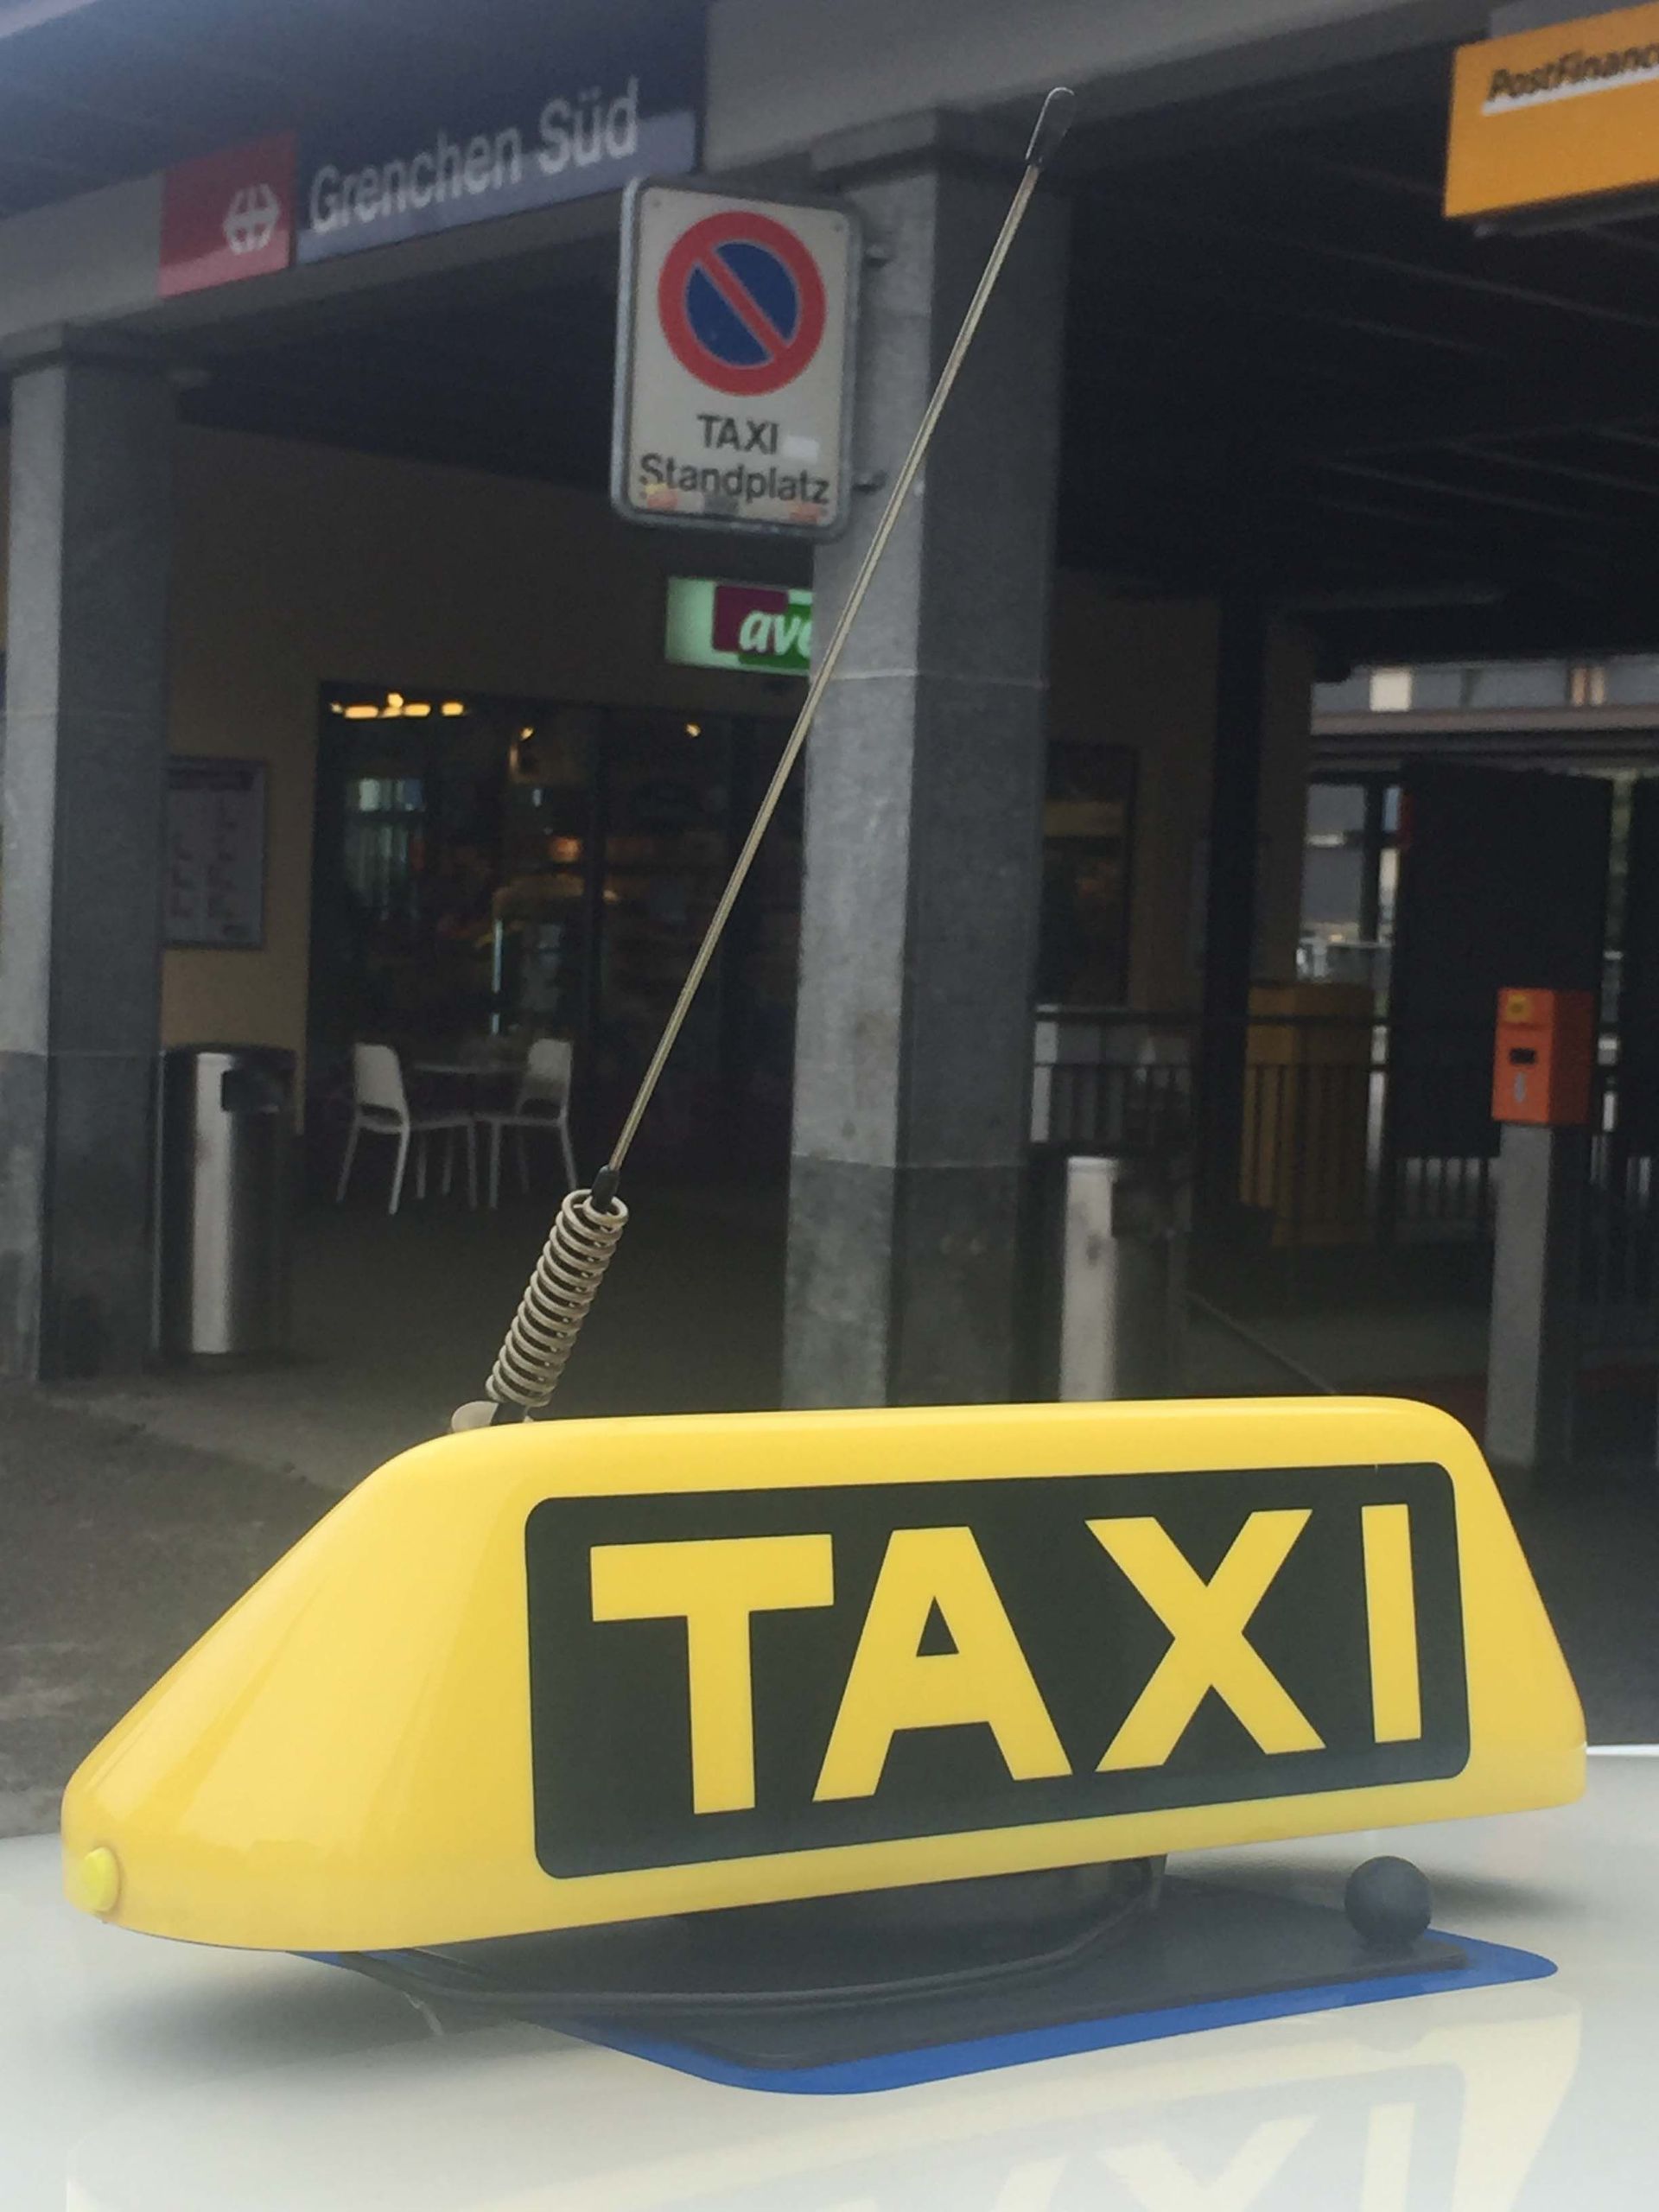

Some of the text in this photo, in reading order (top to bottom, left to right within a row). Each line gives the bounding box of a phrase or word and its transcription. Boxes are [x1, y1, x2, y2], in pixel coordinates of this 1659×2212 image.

[310, 74, 639, 233] Grenchen Süd
[640, 451, 830, 505] Standplatz
[696, 413, 780, 456] TAXI
[590, 1504, 1421, 1815] TAXI
